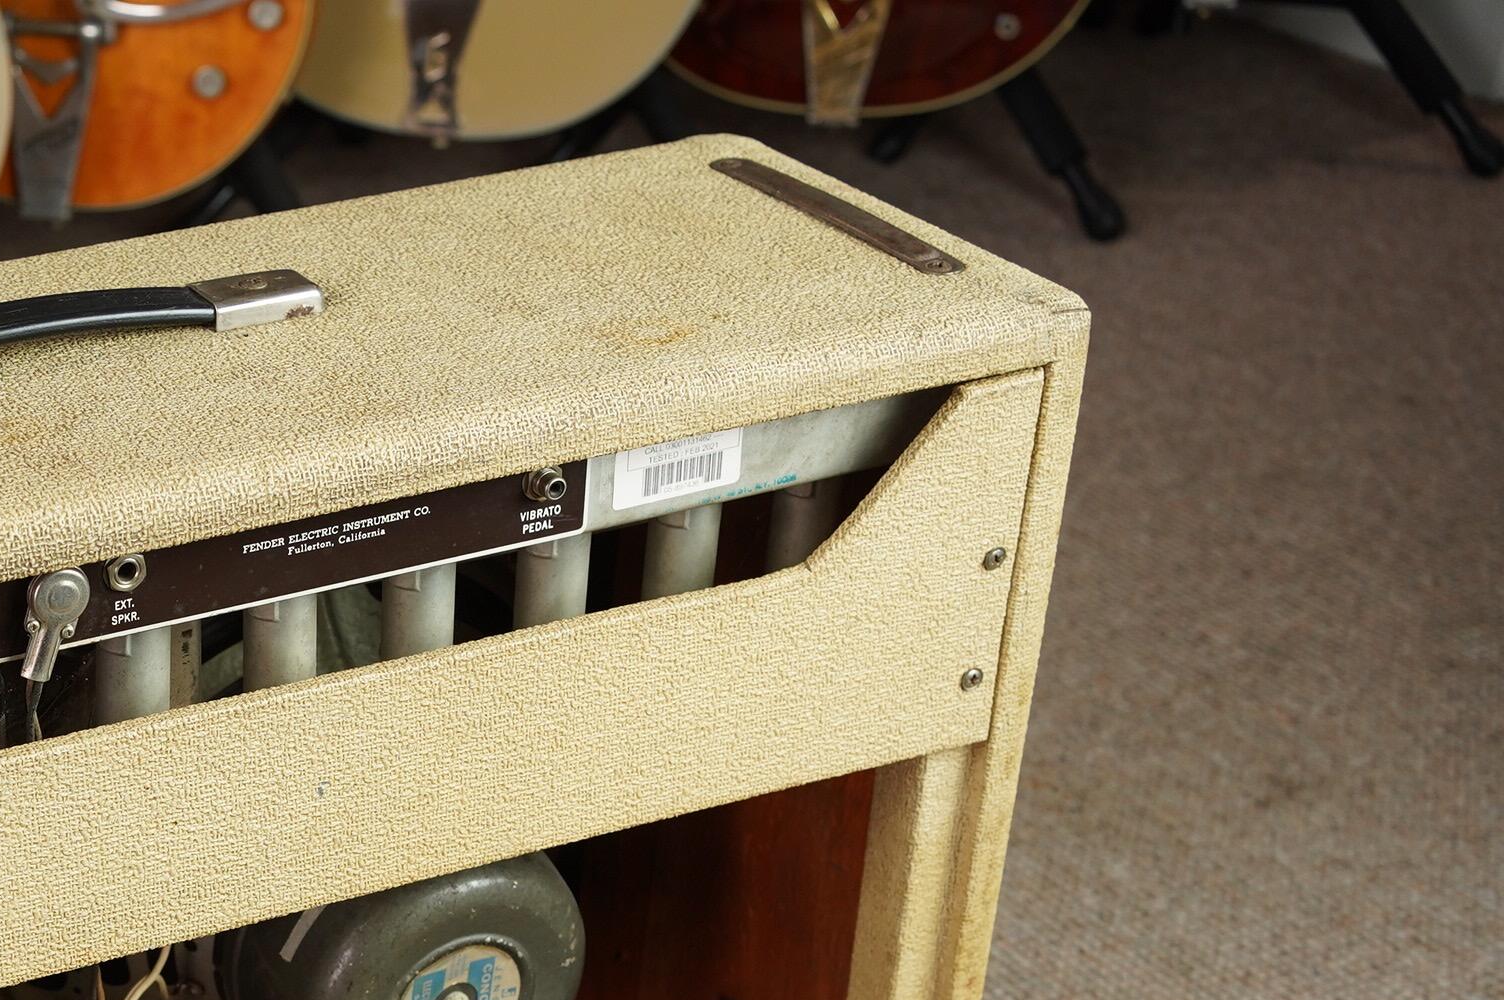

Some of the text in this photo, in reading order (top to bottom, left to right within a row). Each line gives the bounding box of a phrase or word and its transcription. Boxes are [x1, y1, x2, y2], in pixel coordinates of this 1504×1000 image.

[648, 451, 679, 464] TESTED
[685, 446, 701, 456] FEB
[702, 442, 719, 453] 2021
[520, 504, 562, 522] VIBRATO
[242, 506, 431, 554] FENDER ELECTRIC INSTRUMENT CO.
[522, 519, 554, 535] PEDAL
[287, 528, 386, 556] Fullerton, California
[114, 598, 135, 611] EXT.
[111, 611, 140, 626] SPKR.
